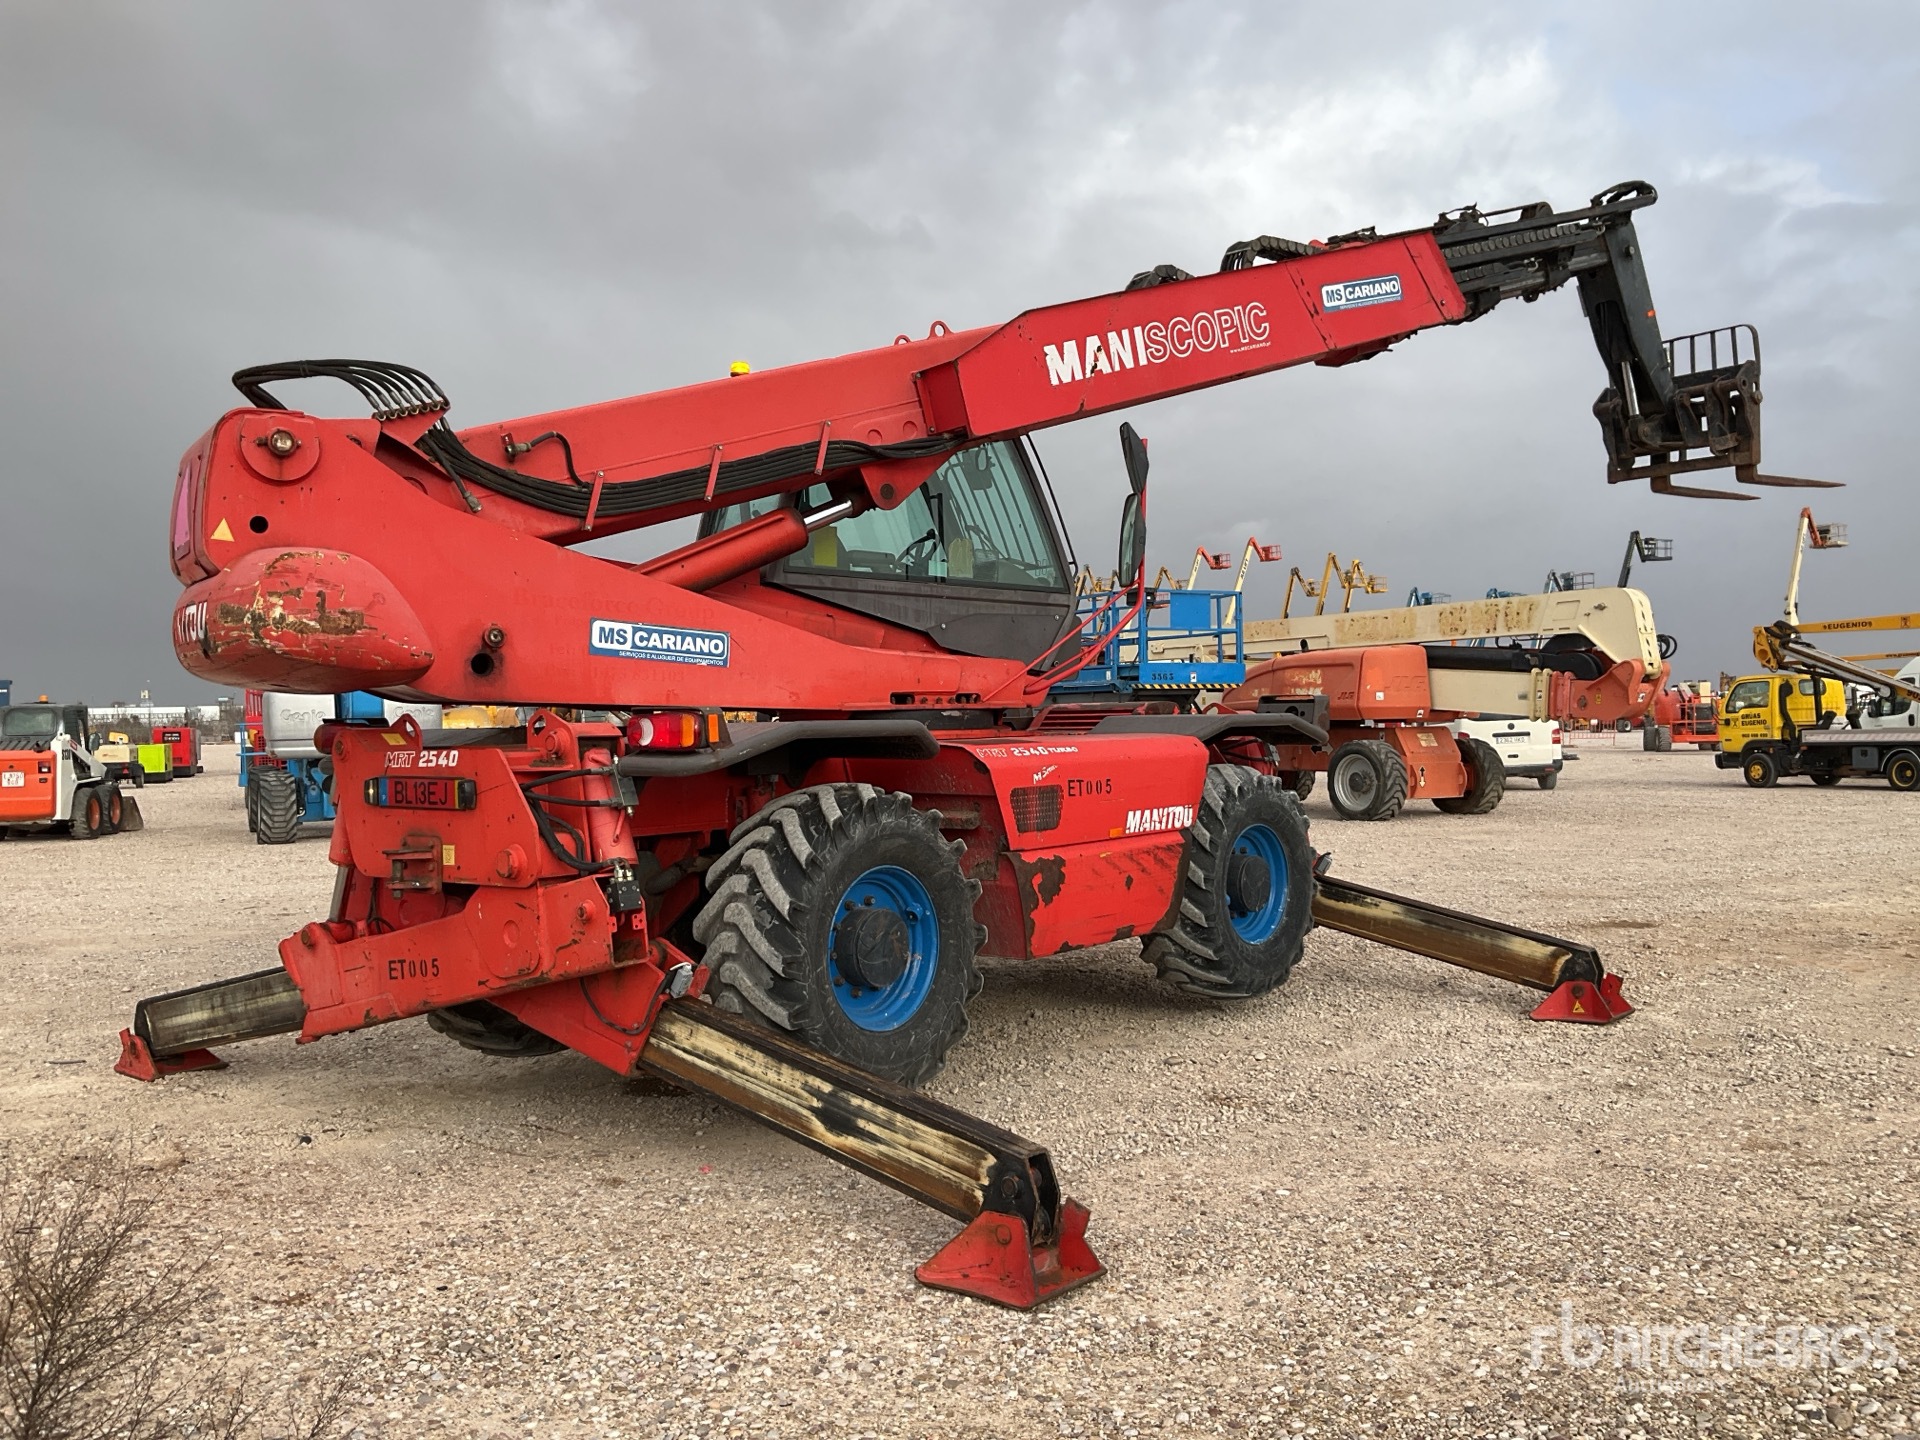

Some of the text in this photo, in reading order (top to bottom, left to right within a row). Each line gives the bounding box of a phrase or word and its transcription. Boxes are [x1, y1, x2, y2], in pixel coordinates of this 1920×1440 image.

[1326, 280, 1399, 303] MS CARIANO
[1043, 301, 1270, 386] MANISCOPIC
[1828, 620, 1868, 630] EUGENIO
[598, 626, 724, 655] MS CARIANO
[280, 708, 326, 722] Genie
[1741, 719, 1767, 727] EUGENIO
[385, 749, 459, 768] MRT 2540
[1010, 746, 1049, 757] 2540
[394, 780, 448, 805] BL13EJ
